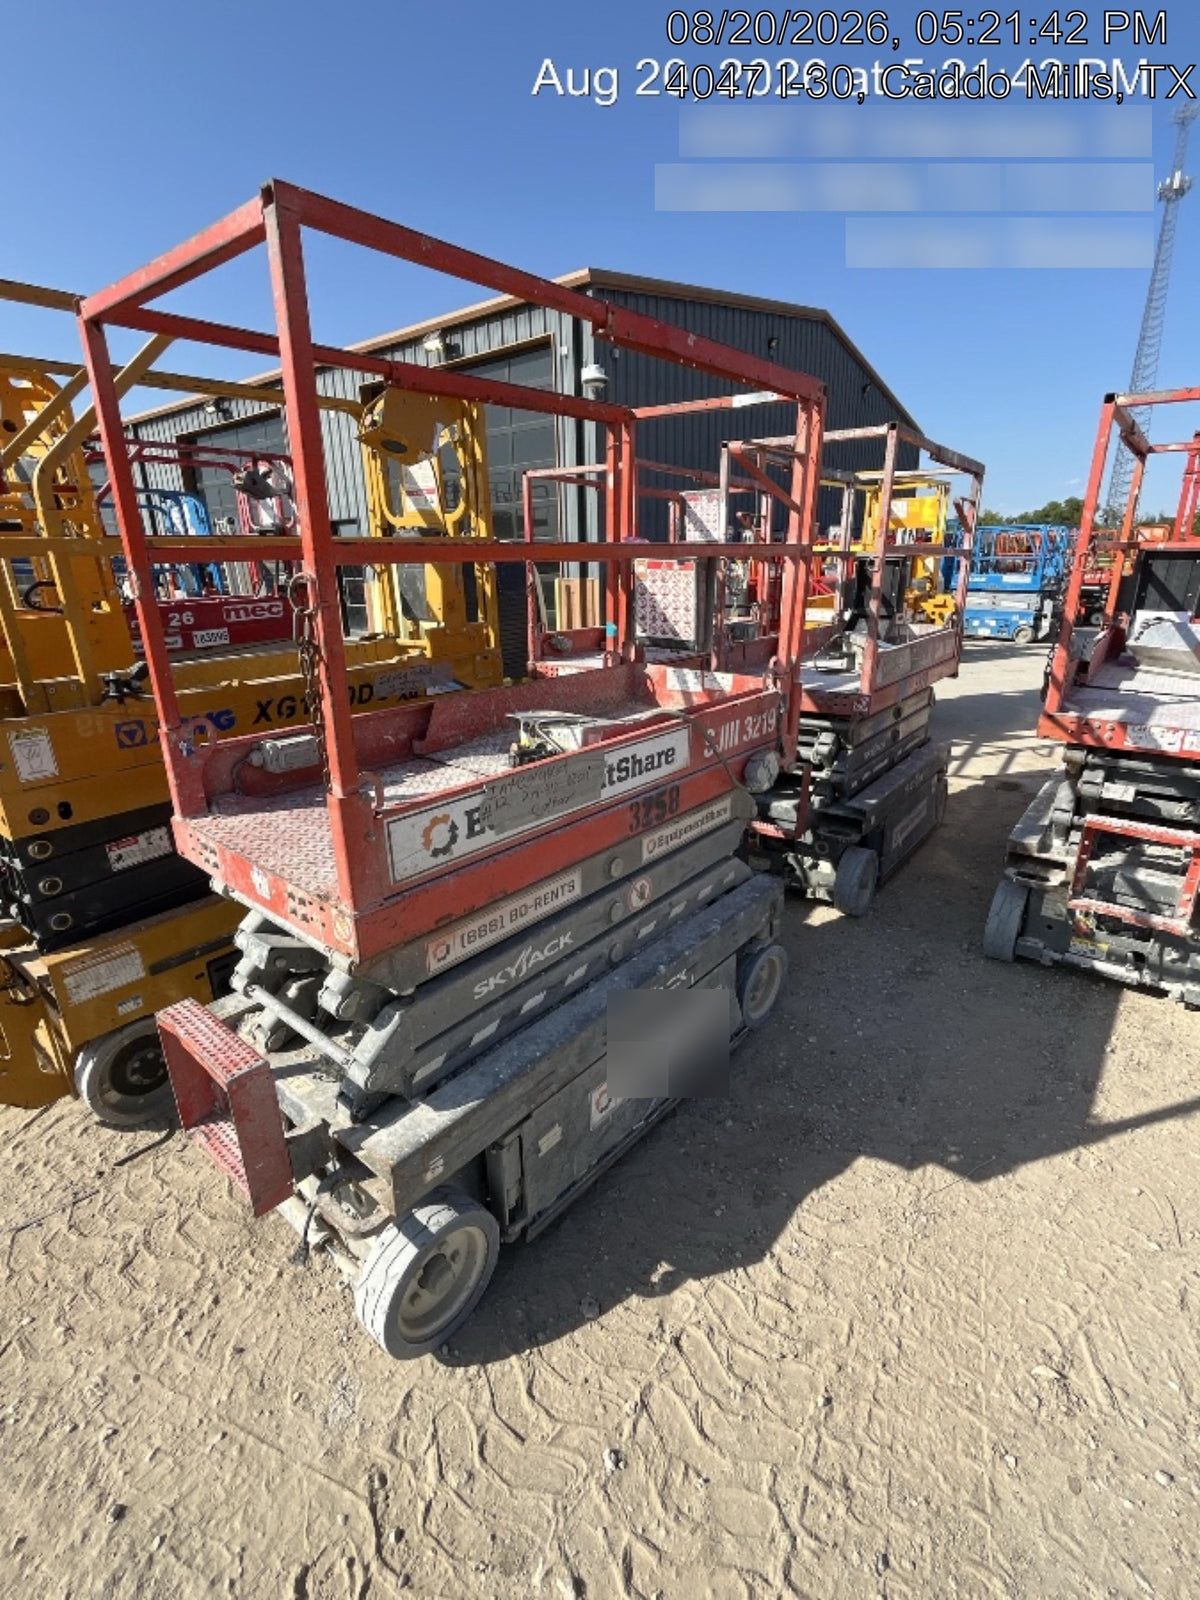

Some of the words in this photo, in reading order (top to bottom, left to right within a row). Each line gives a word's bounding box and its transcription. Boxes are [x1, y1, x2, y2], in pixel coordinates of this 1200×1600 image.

[168, 610, 195, 627] 26
[223, 601, 284, 622] mec
[742, 707, 777, 743] 3219
[473, 930, 575, 1001] SKYJACK
